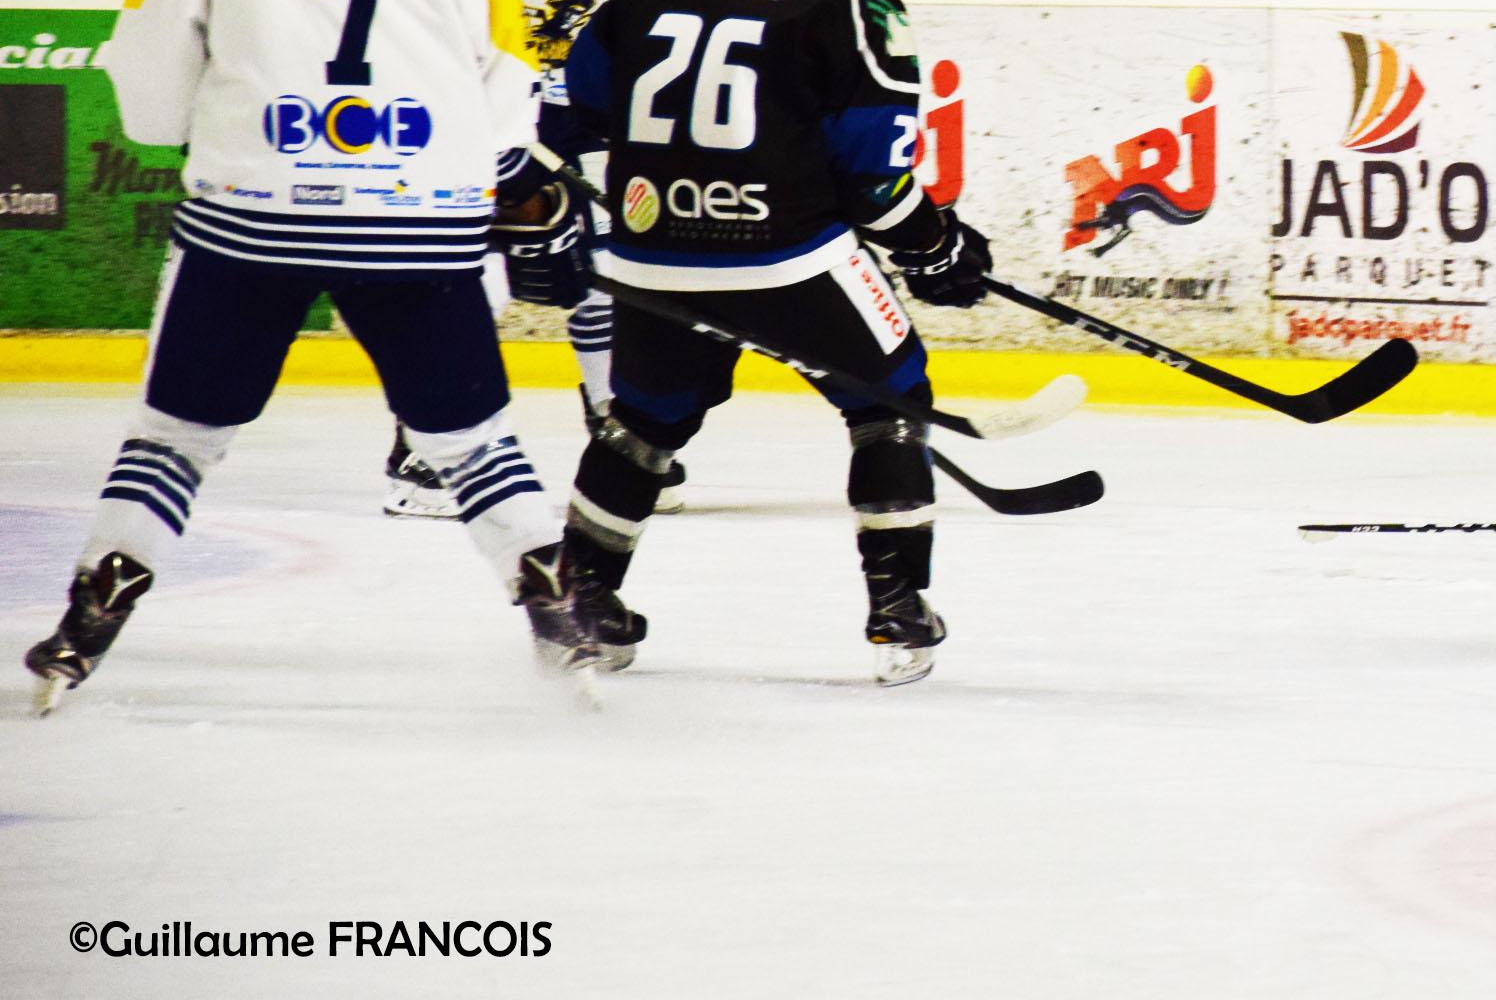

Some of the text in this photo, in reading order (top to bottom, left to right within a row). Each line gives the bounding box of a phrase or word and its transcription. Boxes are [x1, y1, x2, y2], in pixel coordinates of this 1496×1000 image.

[626, 11, 768, 151] 26
[264, 95, 431, 155] BCE
[667, 178, 770, 221] aes
[1270, 158, 1489, 243] JAD'O
[1269, 252, 1491, 289] PARQUET
